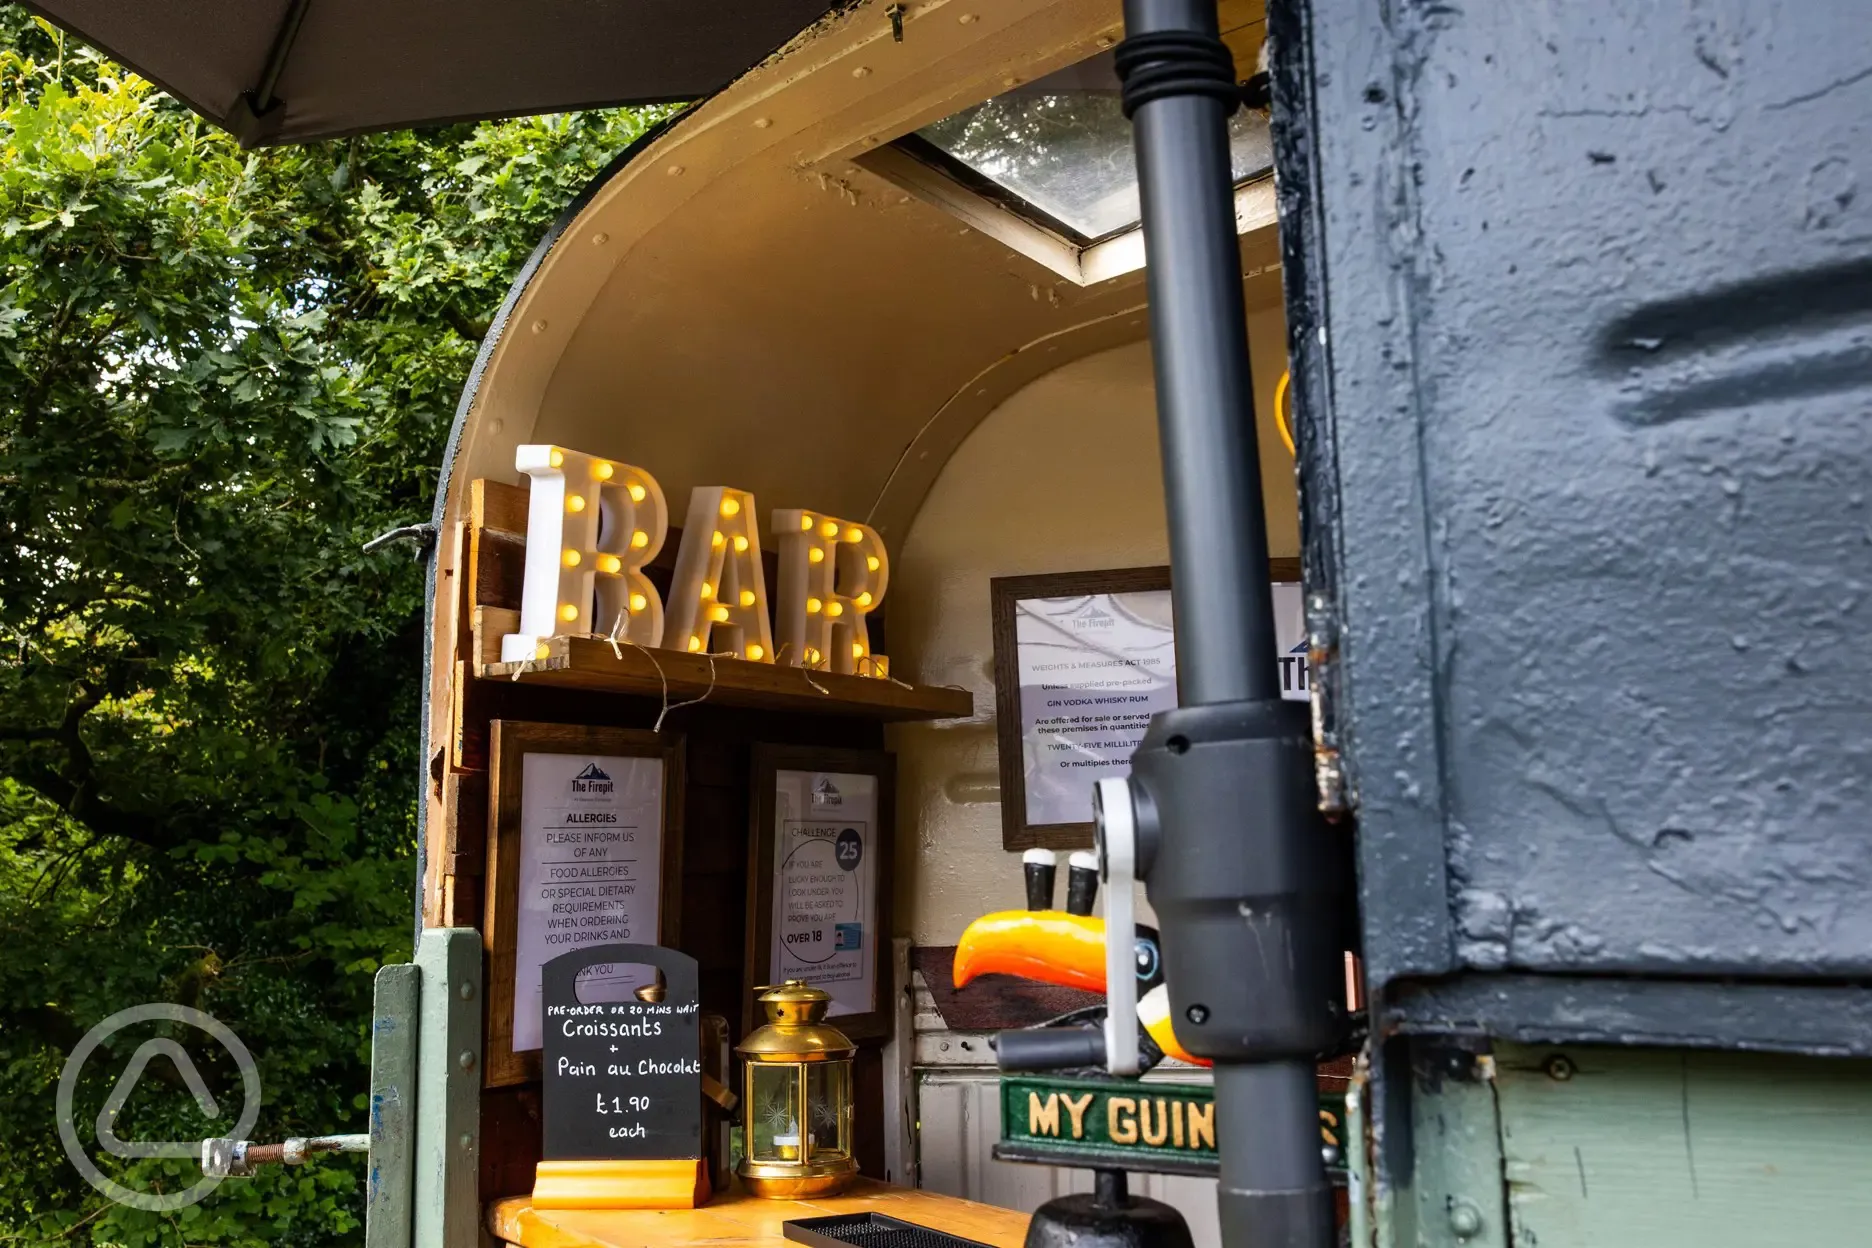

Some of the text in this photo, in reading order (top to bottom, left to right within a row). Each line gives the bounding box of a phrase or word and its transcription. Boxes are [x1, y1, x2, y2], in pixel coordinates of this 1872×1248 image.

[501, 444, 889, 679] BAR
[1032, 663, 1069, 672] WEIGHTS
[1078, 660, 1123, 669] MEASURES
[1070, 679, 1104, 690] supplied
[1106, 677, 1152, 688] pre-packed
[1063, 698, 1093, 706] VODKA
[1095, 696, 1127, 704] WHISKY
[1129, 695, 1148, 703] RUM
[1051, 716, 1080, 724] offered
[1081, 715, 1093, 723] for
[1123, 713, 1150, 721] served
[1038, 726, 1060, 734] these
[1062, 725, 1098, 735] premises
[1047, 741, 1101, 751] TWENTY-FIVE
[1072, 759, 1110, 768] multiples
[571, 780, 613, 795] The Firepit
[566, 813, 617, 823] ALLERGIES
[546, 832, 635, 843] PLEASE INFORM US
[791, 827, 858, 860] CHALLENGE 25
[573, 847, 608, 858] OF ANY
[550, 866, 629, 878] FOOD ALLERGIES
[788, 874, 846, 884] LUCKY ENOUGH TO
[541, 885, 636, 899] OR SPECIAL DIETARY
[788, 887, 844, 896] LOOK UNDER YOU
[552, 900, 625, 914] REQUIREMENTS
[788, 902, 803, 910] WILL
[805, 901, 813, 909] BE
[815, 900, 834, 908] ASKED
[547, 914, 629, 928] WHEN ORDERING
[787, 914, 809, 923] PROVE
[545, 929, 630, 944] YOUR DRINKS AND
[787, 930, 822, 944] OVER 18
[594, 964, 613, 975] YOU
[547, 1005, 604, 1016] PRE-ORDER
[611, 1005, 625, 1015] OR
[629, 1005, 642, 1015] 20
[562, 1016, 662, 1037] Croissants
[558, 1056, 700, 1076] Pain au Chocolat
[596, 1092, 650, 1114] £1.90
[1029, 1091, 1093, 1139] MY
[609, 1122, 646, 1138] each
